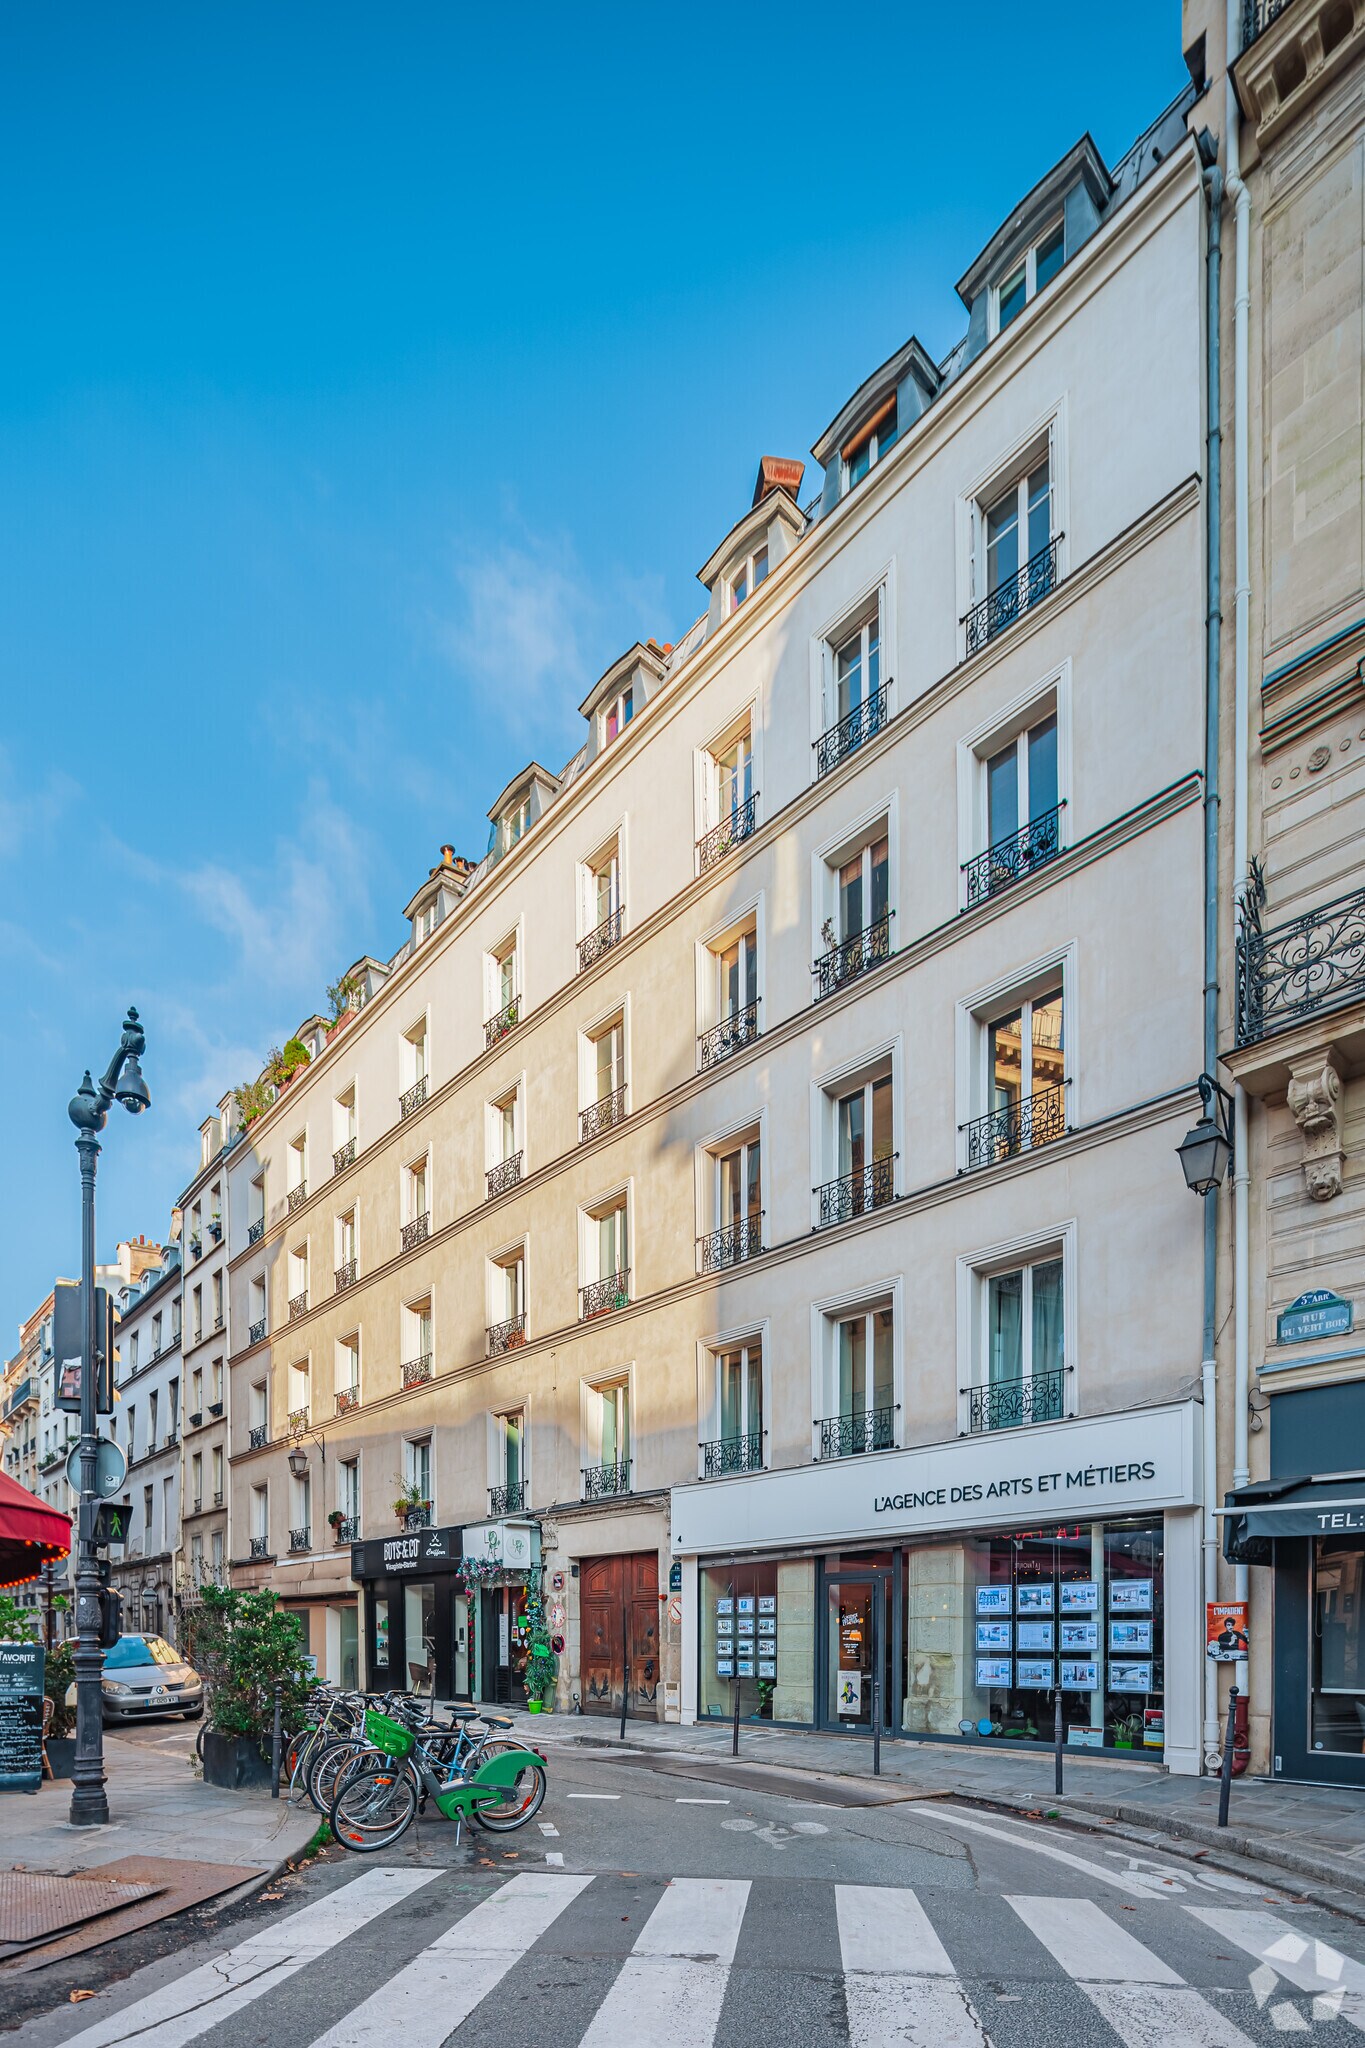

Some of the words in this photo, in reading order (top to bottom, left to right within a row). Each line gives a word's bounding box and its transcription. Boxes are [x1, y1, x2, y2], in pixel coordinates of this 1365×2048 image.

[1302, 1312, 1326, 1323] RUE
[1281, 1328, 1295, 1338] DU
[1298, 1322, 1324, 1334] VERT
[1325, 1318, 1348, 1329] BOIS
[874, 1489, 946, 1512] L'AGENCE
[950, 1485, 983, 1502] DES
[986, 1478, 1033, 1498] ARTS
[1038, 1473, 1061, 1492] ET
[1066, 1461, 1155, 1488] MÉTIERS
[1317, 1512, 1365, 1528] TEL:
